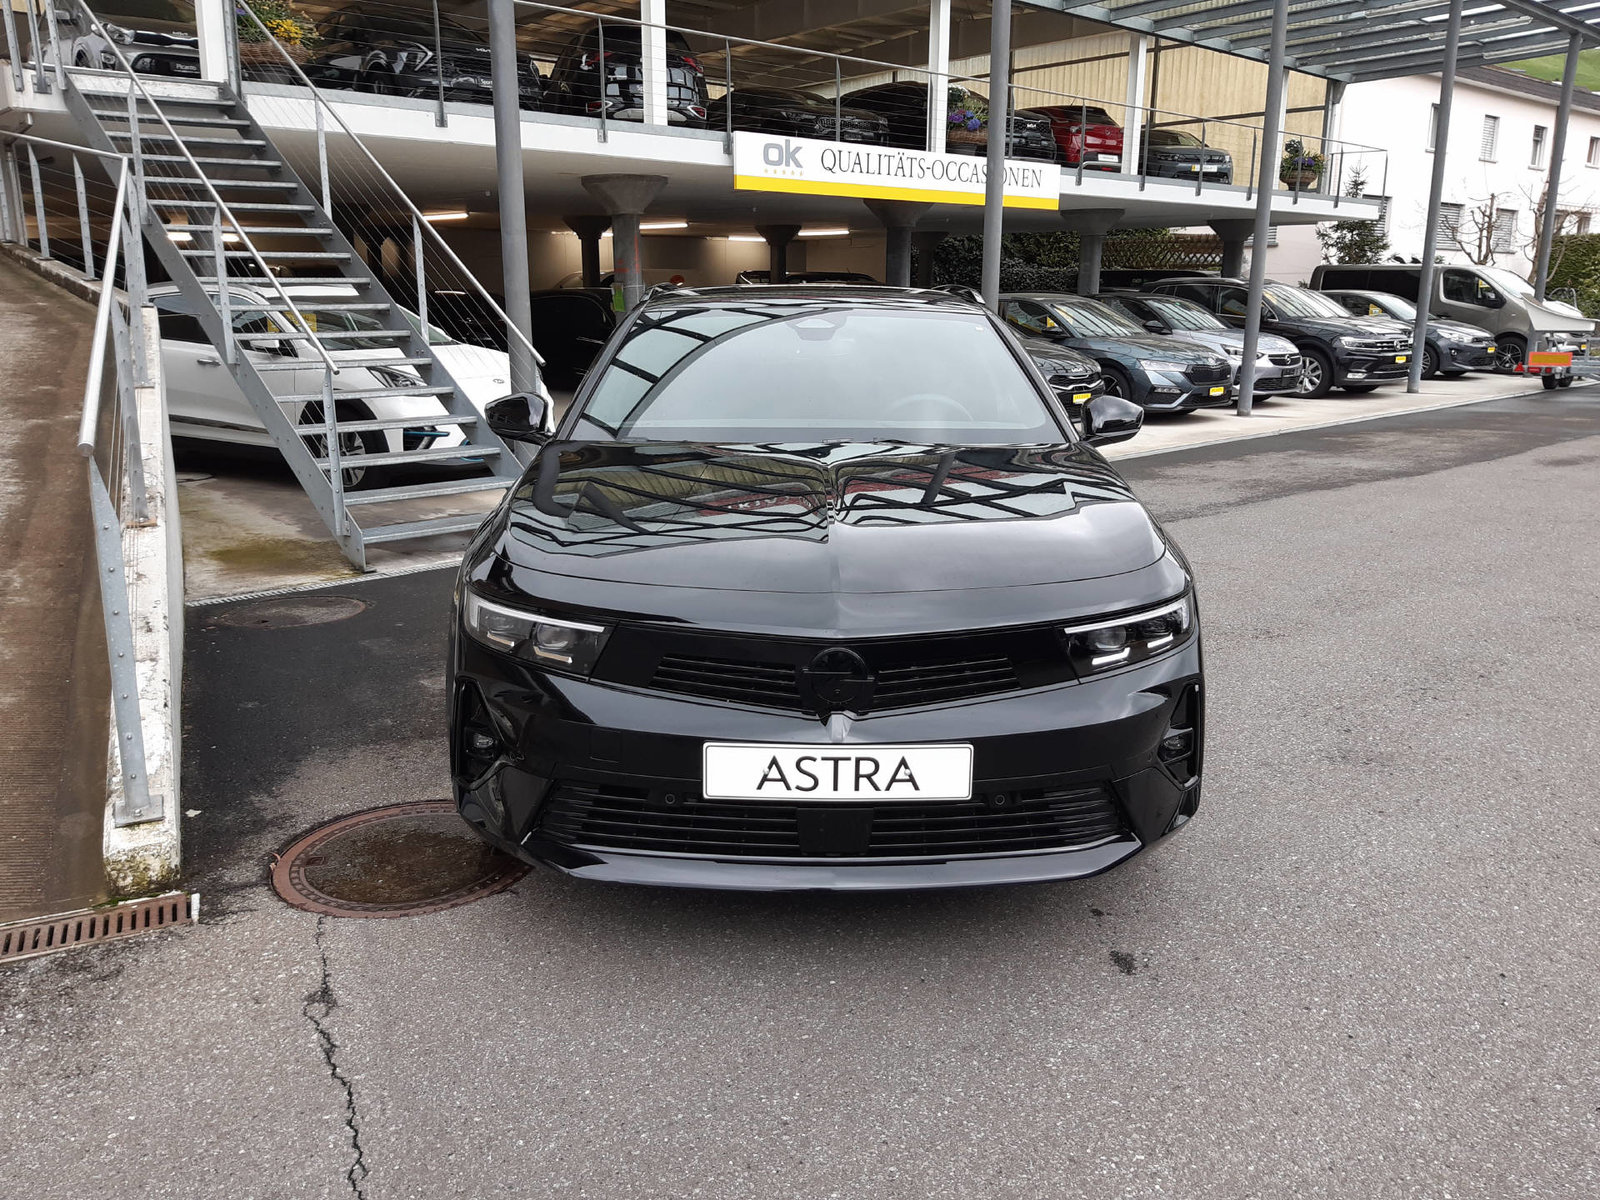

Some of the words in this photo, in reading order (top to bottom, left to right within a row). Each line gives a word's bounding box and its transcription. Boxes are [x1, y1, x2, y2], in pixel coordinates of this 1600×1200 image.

[763, 139, 803, 168] ok
[821, 148, 1042, 188] QUALITÄTS-OCCASNEN
[756, 755, 920, 792] ASTRA
